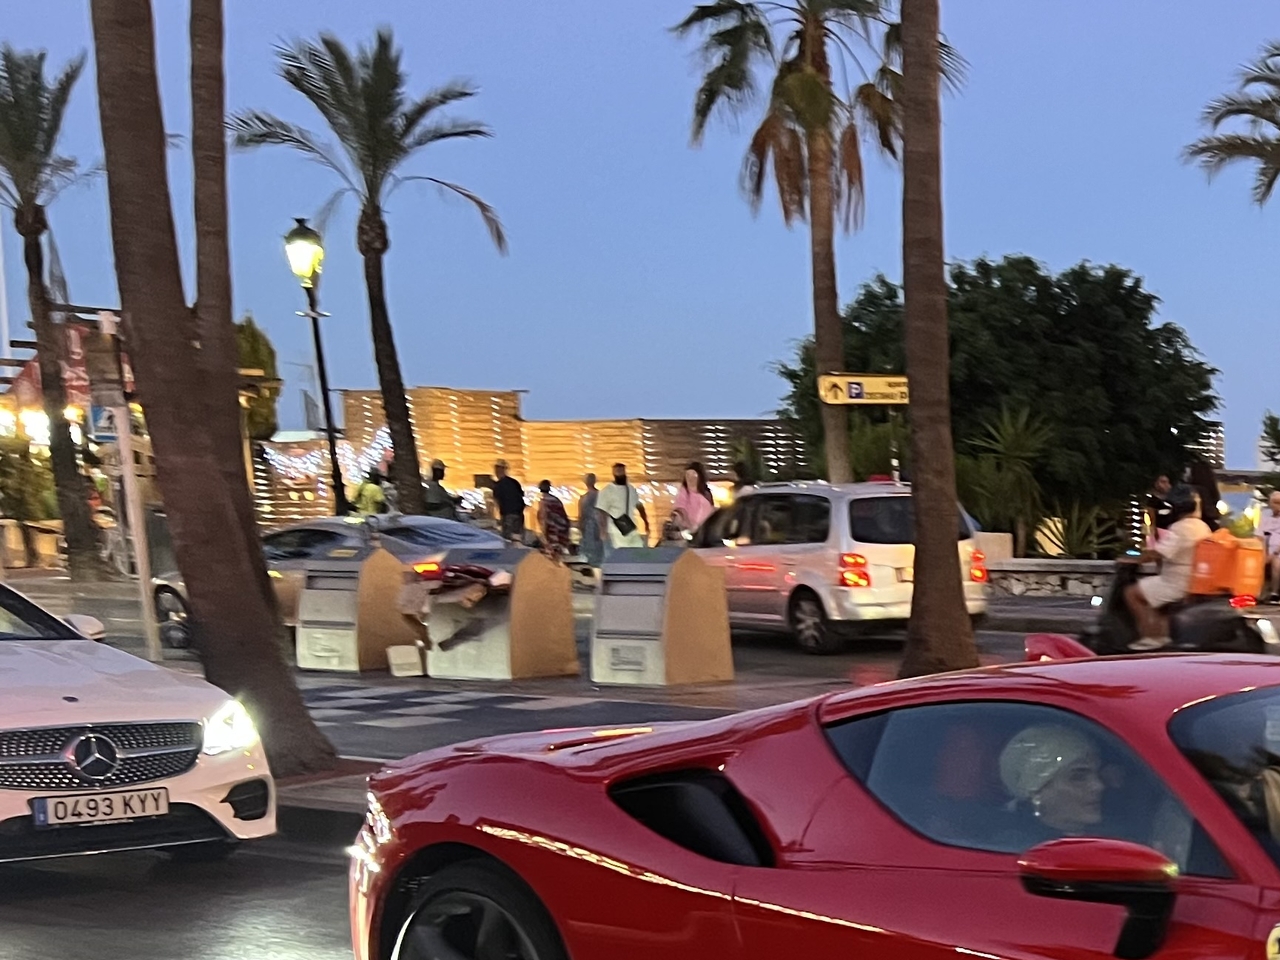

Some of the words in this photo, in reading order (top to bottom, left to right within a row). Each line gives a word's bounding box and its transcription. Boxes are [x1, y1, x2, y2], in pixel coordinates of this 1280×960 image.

[850, 383, 861, 398] P
[54, 797, 115, 821] 0493
[122, 792, 162, 815] KYY
